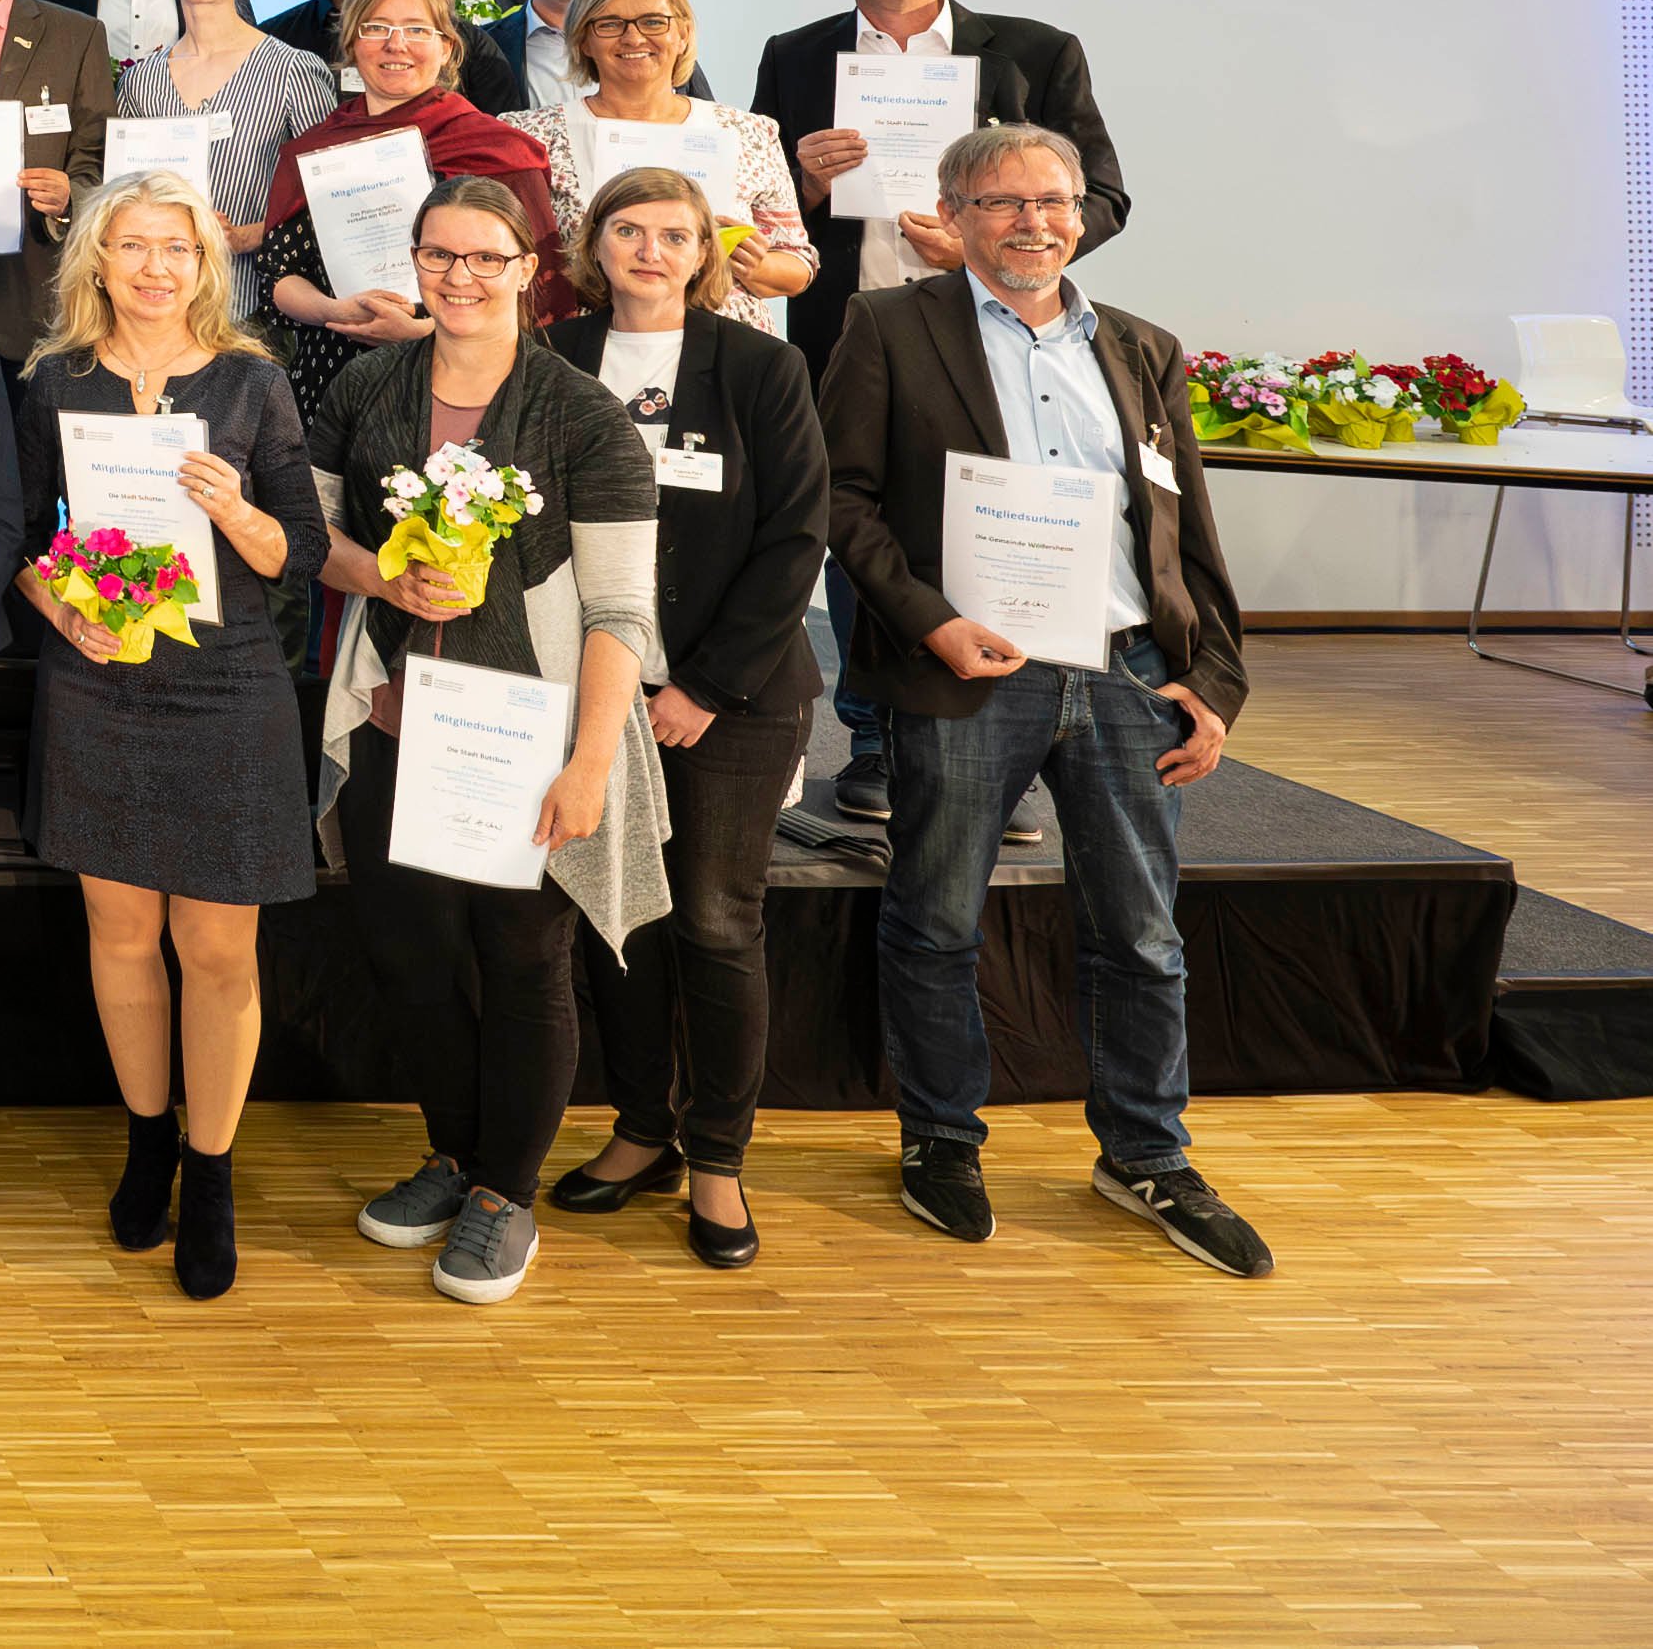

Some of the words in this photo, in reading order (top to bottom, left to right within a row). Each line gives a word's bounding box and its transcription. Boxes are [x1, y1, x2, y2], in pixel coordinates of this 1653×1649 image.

[861, 93, 949, 107] Mitgliedsurkunde
[91, 462, 181, 478] Mitgliedsurkunde
[975, 504, 1081, 528] Mitgliedsurkunde
[975, 533, 987, 541] Die
[433, 712, 535, 741] Mitgliedsurkunde
